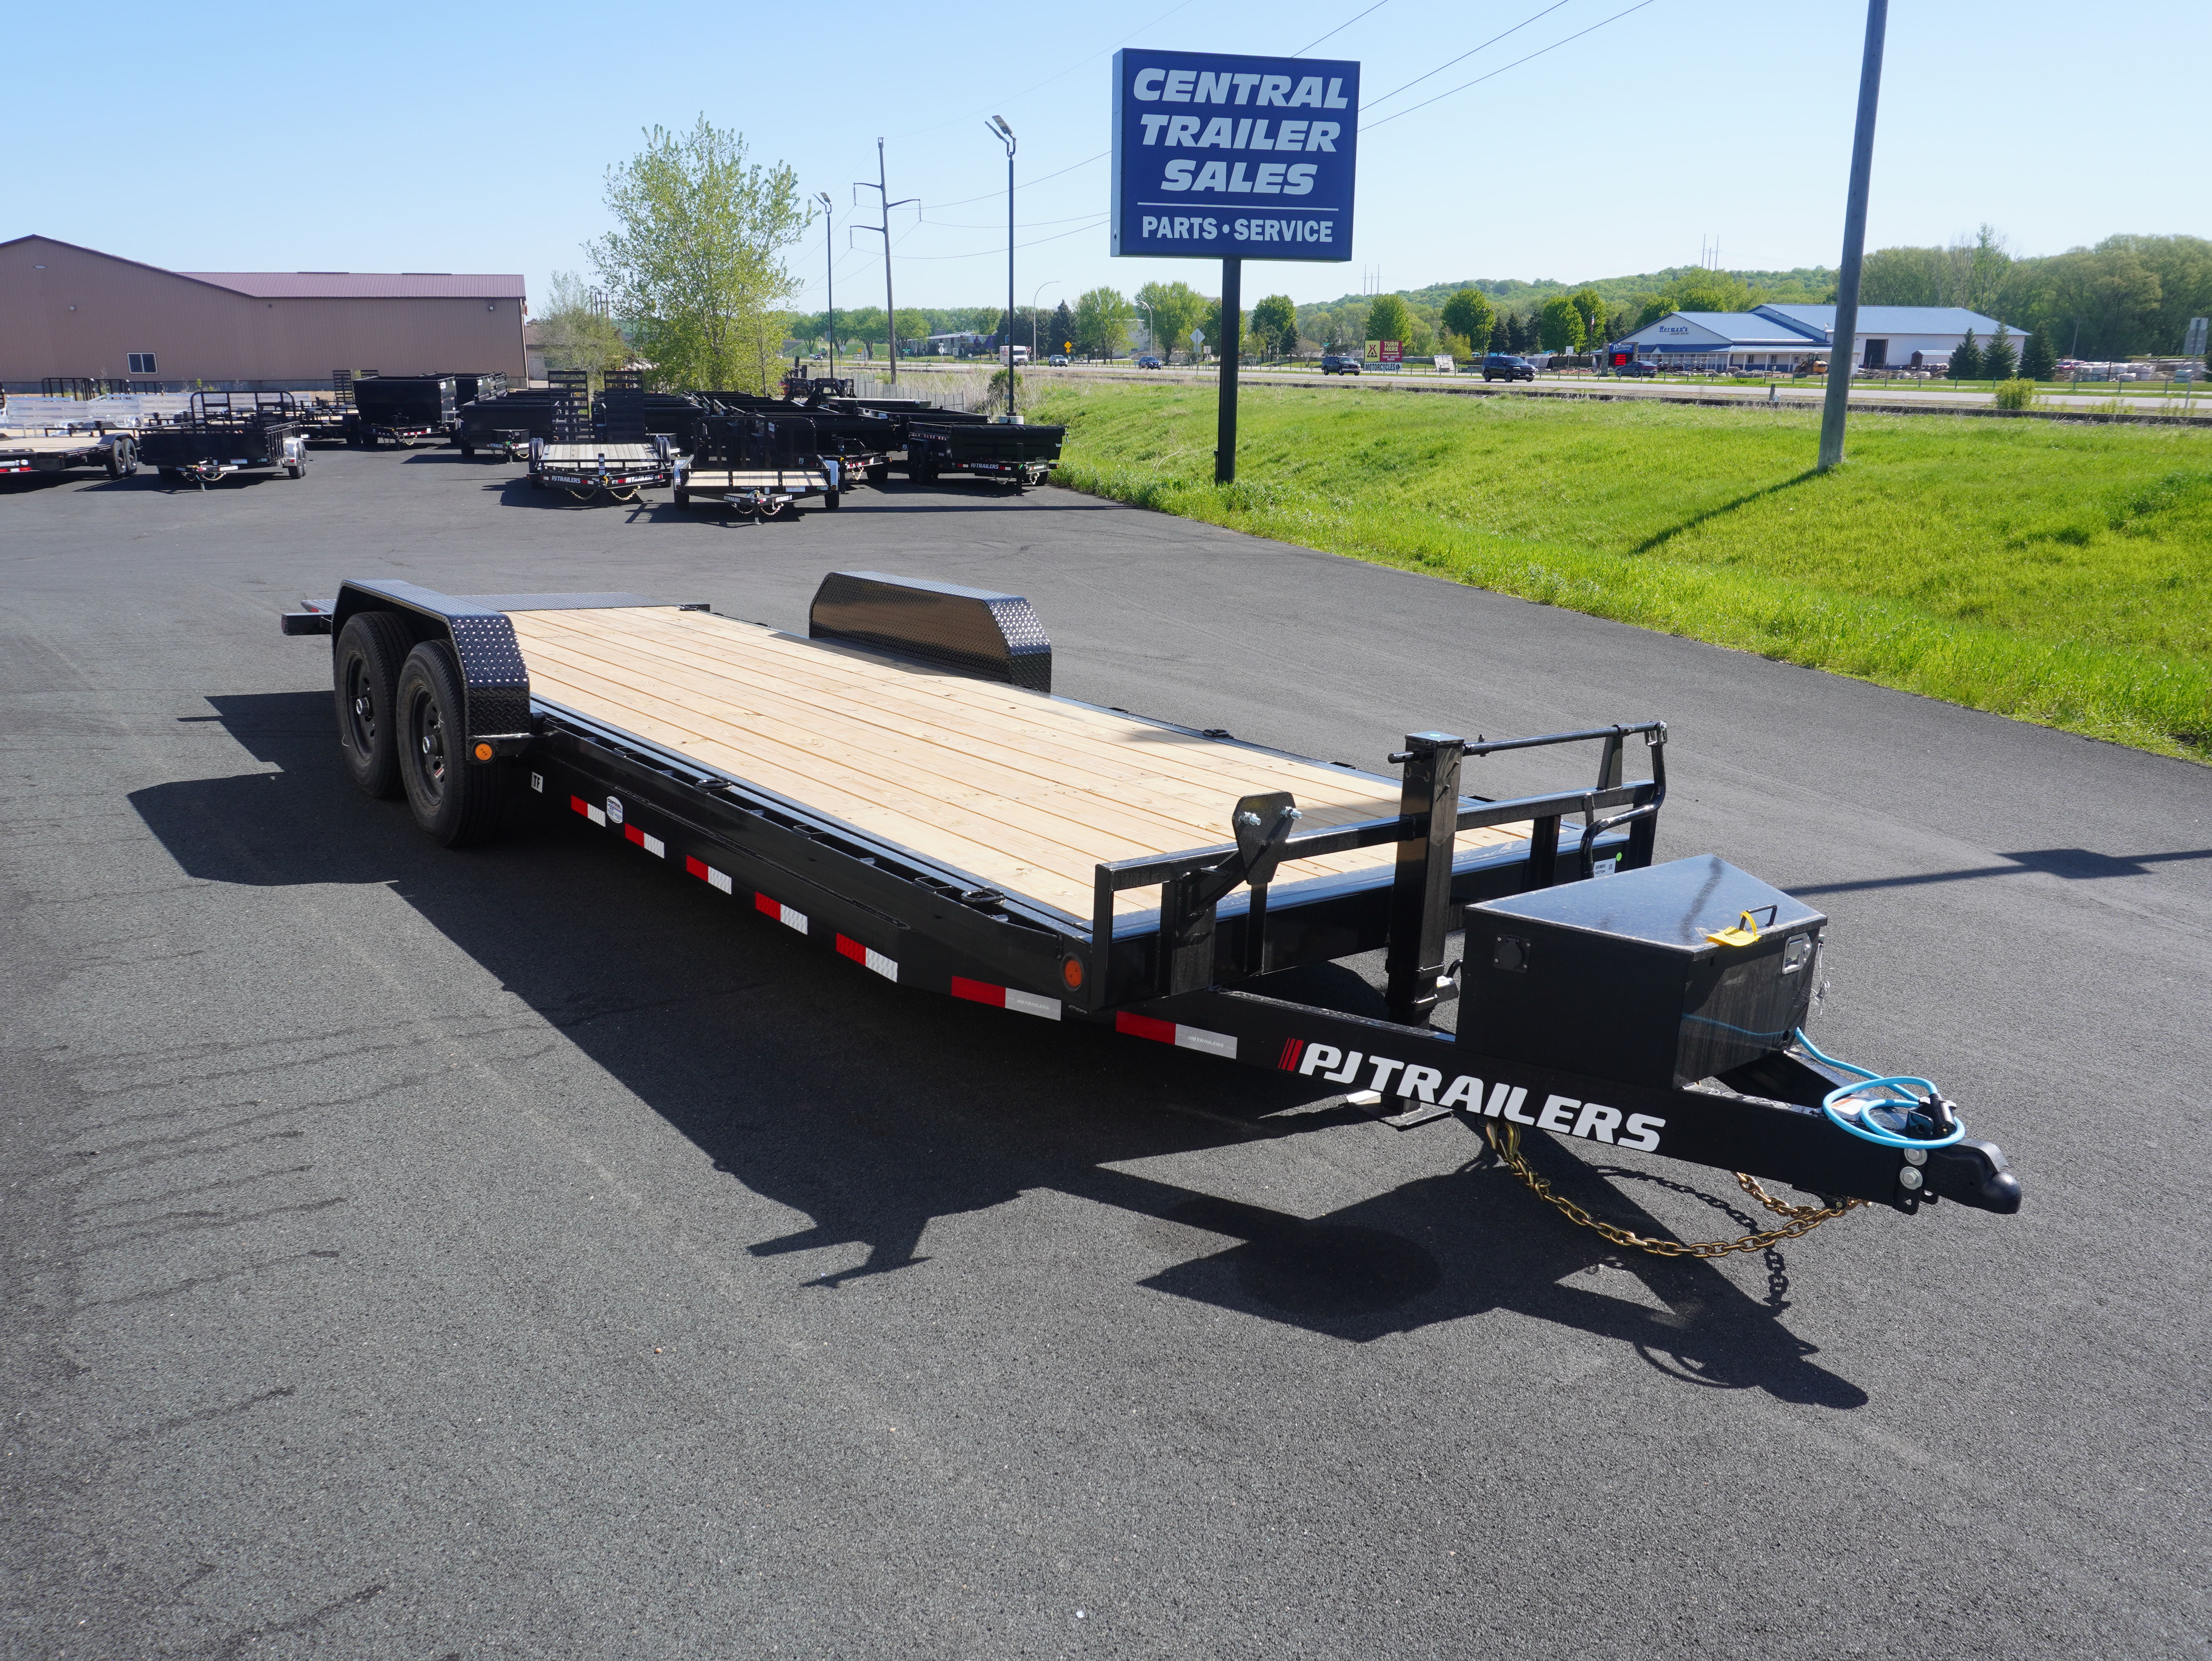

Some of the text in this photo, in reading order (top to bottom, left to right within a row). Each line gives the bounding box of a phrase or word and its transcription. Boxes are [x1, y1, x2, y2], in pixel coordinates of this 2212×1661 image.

[1133, 67, 1349, 109] CENTRAL
[1140, 114, 1341, 152] TRAILER
[1160, 159, 1318, 195] SALES
[1143, 216, 1333, 242] PARTS SERVICE
[534, 775, 540, 788] TF
[1369, 1055, 1666, 1151] TRAILERS
